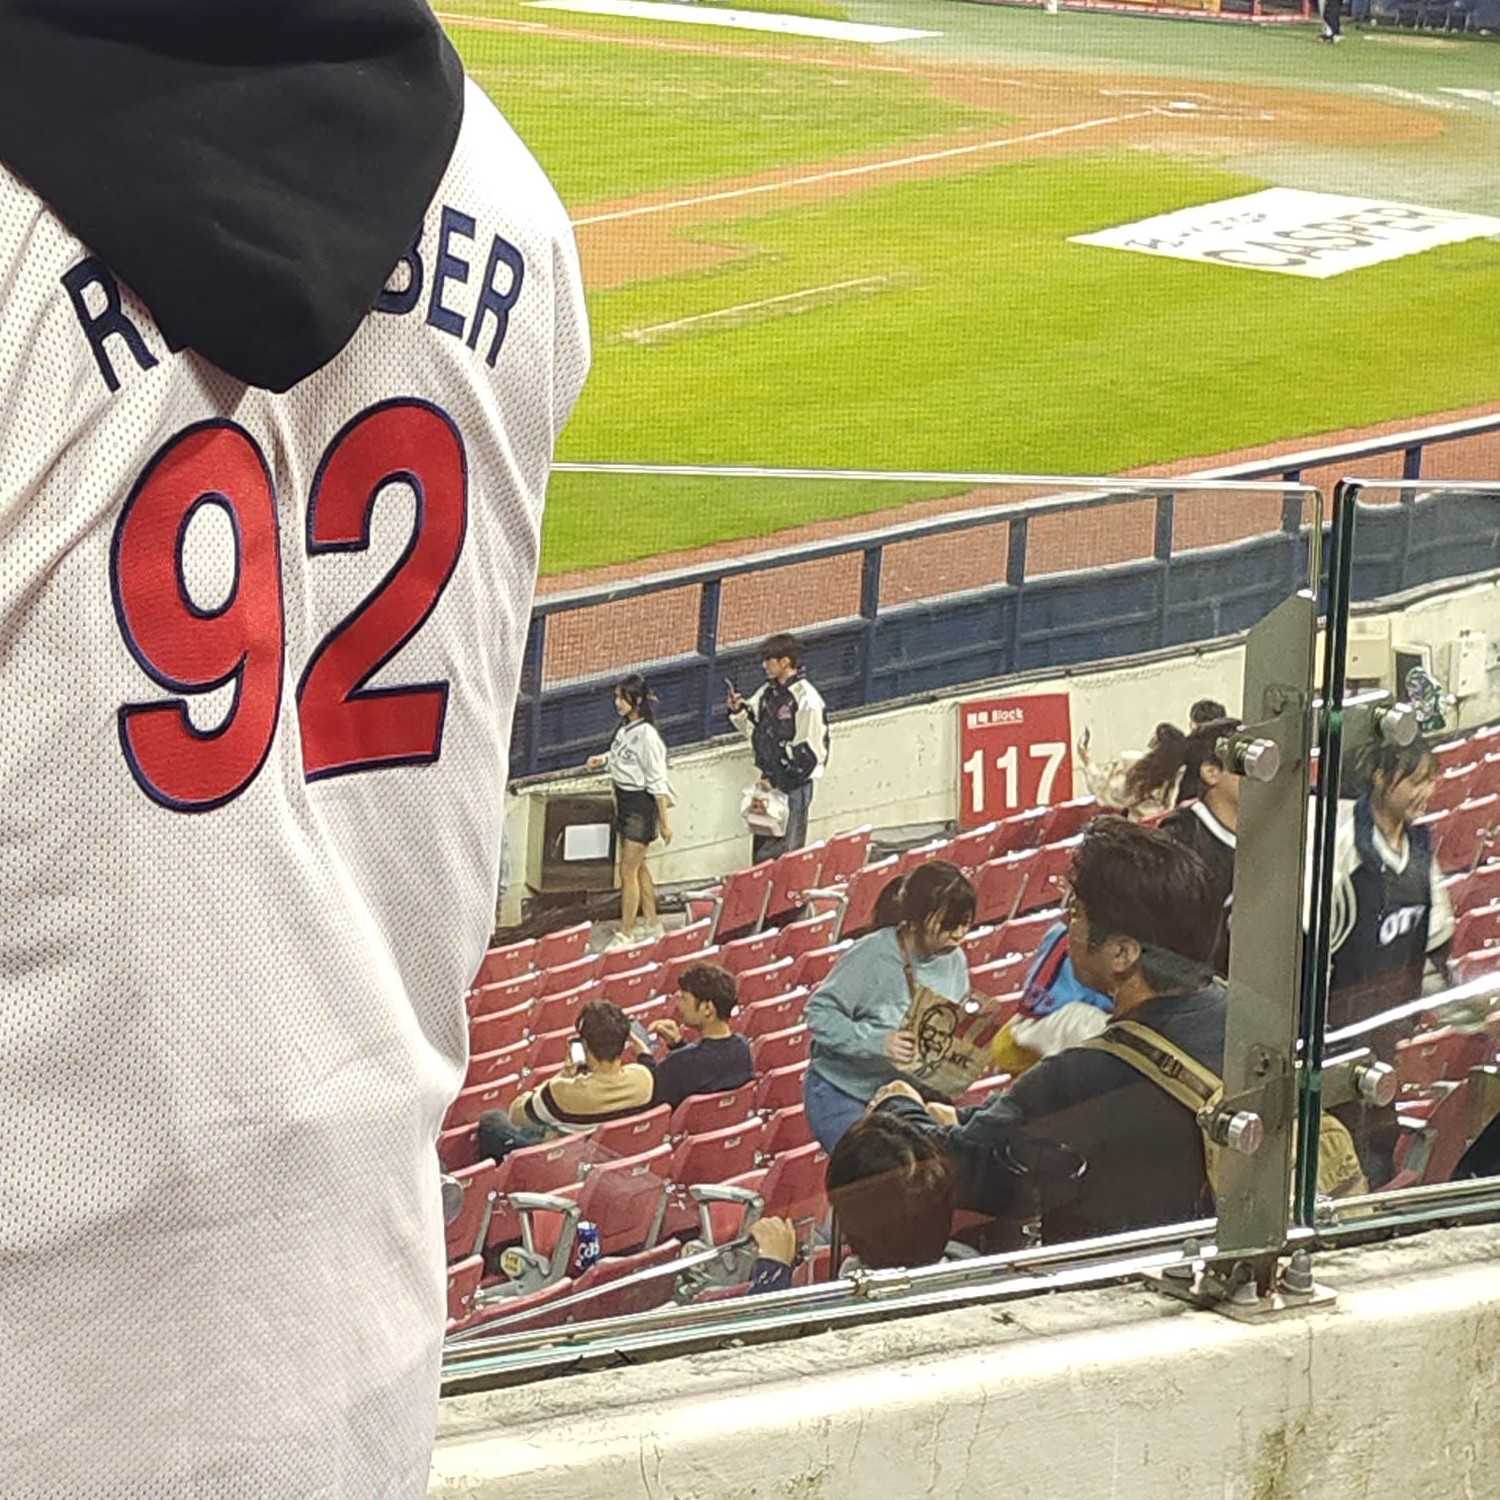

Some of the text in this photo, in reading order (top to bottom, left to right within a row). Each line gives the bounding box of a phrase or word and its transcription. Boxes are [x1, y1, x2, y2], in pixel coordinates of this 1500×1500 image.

[109, 396, 468, 812] 92
[992, 707, 1024, 723] Block
[964, 742, 1067, 813] 117
